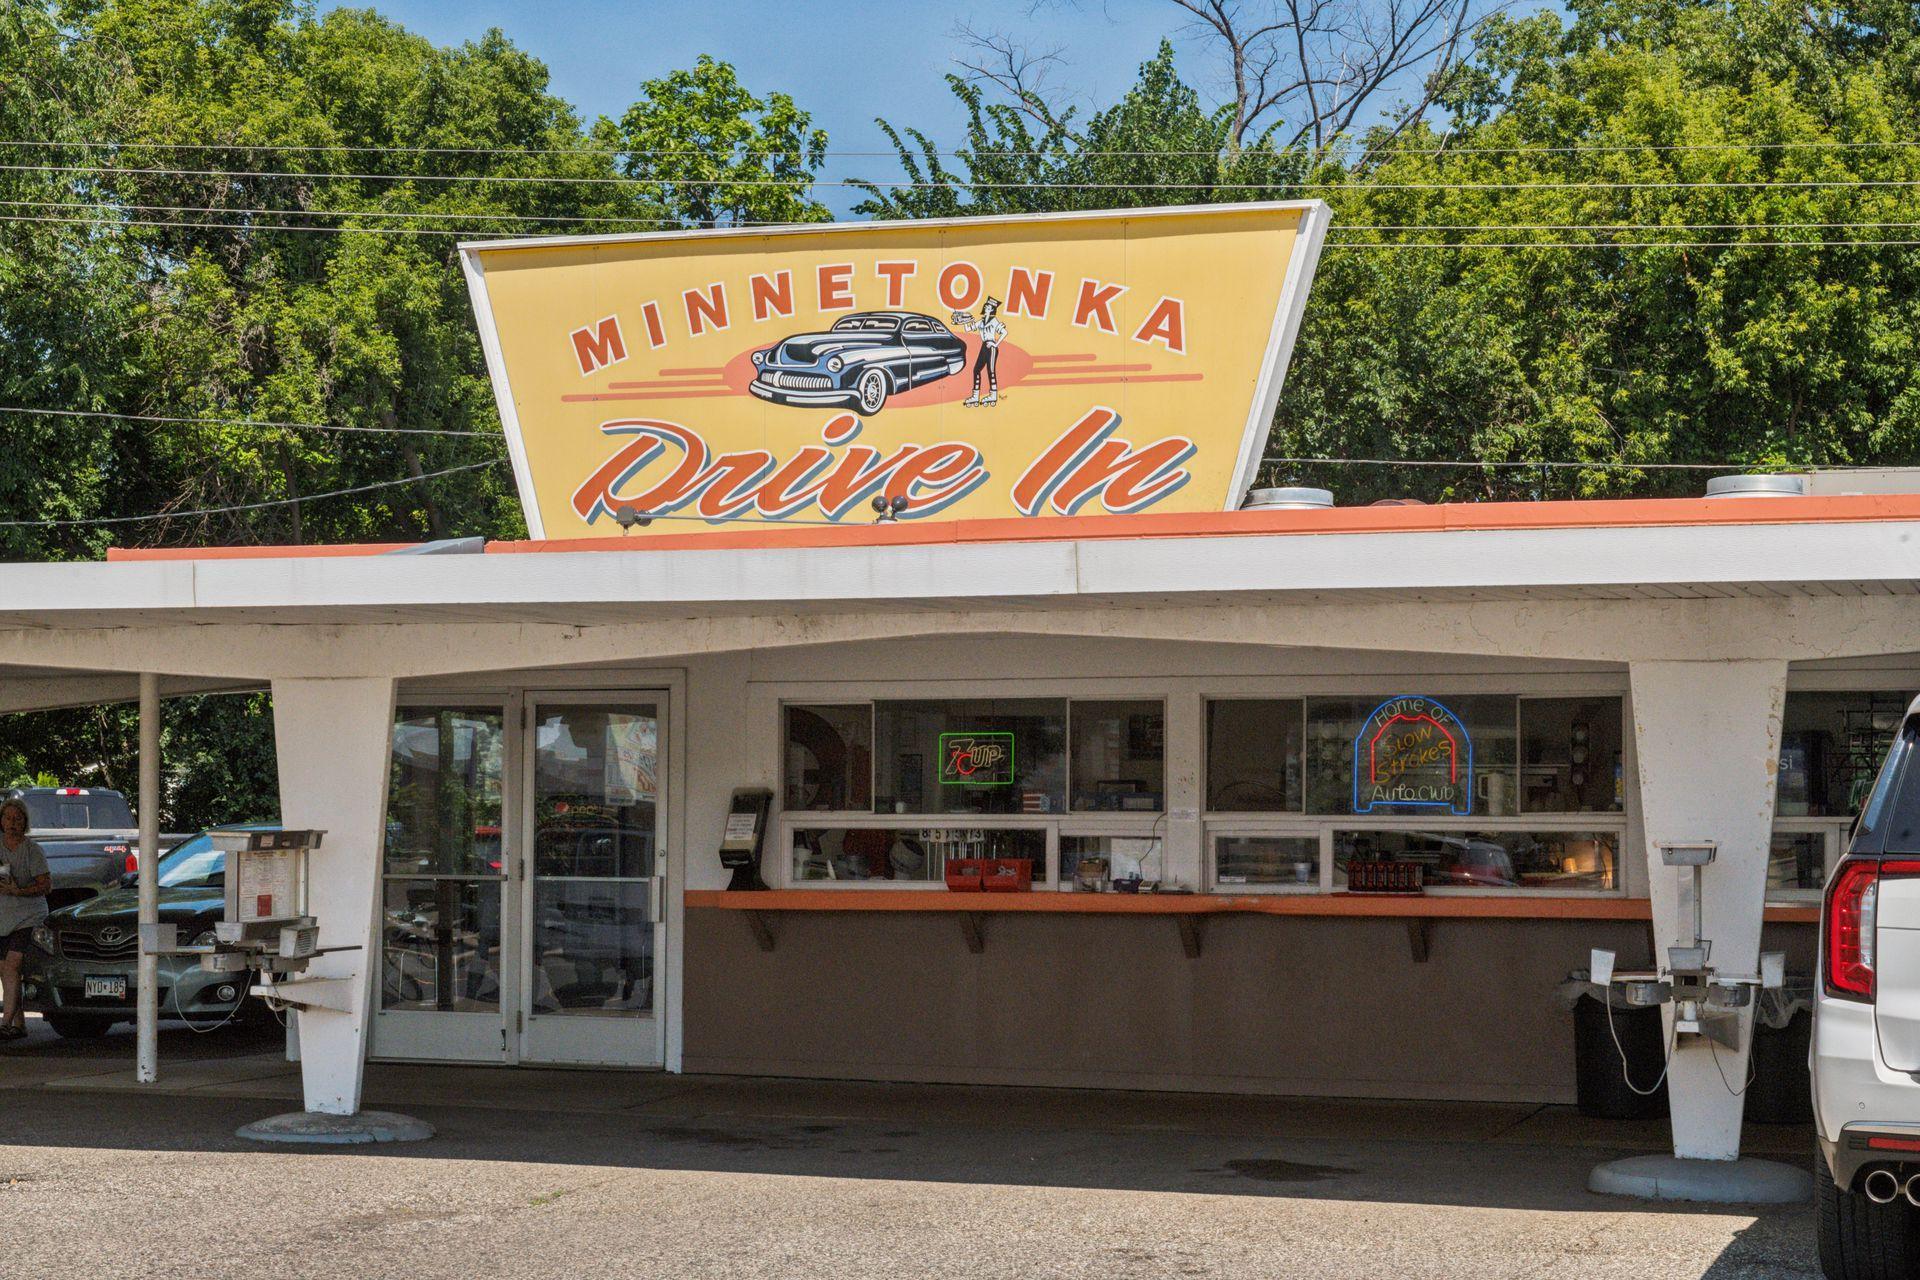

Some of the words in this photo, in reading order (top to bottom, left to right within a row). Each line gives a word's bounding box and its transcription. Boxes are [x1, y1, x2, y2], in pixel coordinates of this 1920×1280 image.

[569, 261, 1186, 377] MINNETONKA
[571, 413, 990, 526] Drive
[1010, 405, 1198, 518] In
[1374, 699, 1425, 727] Home
